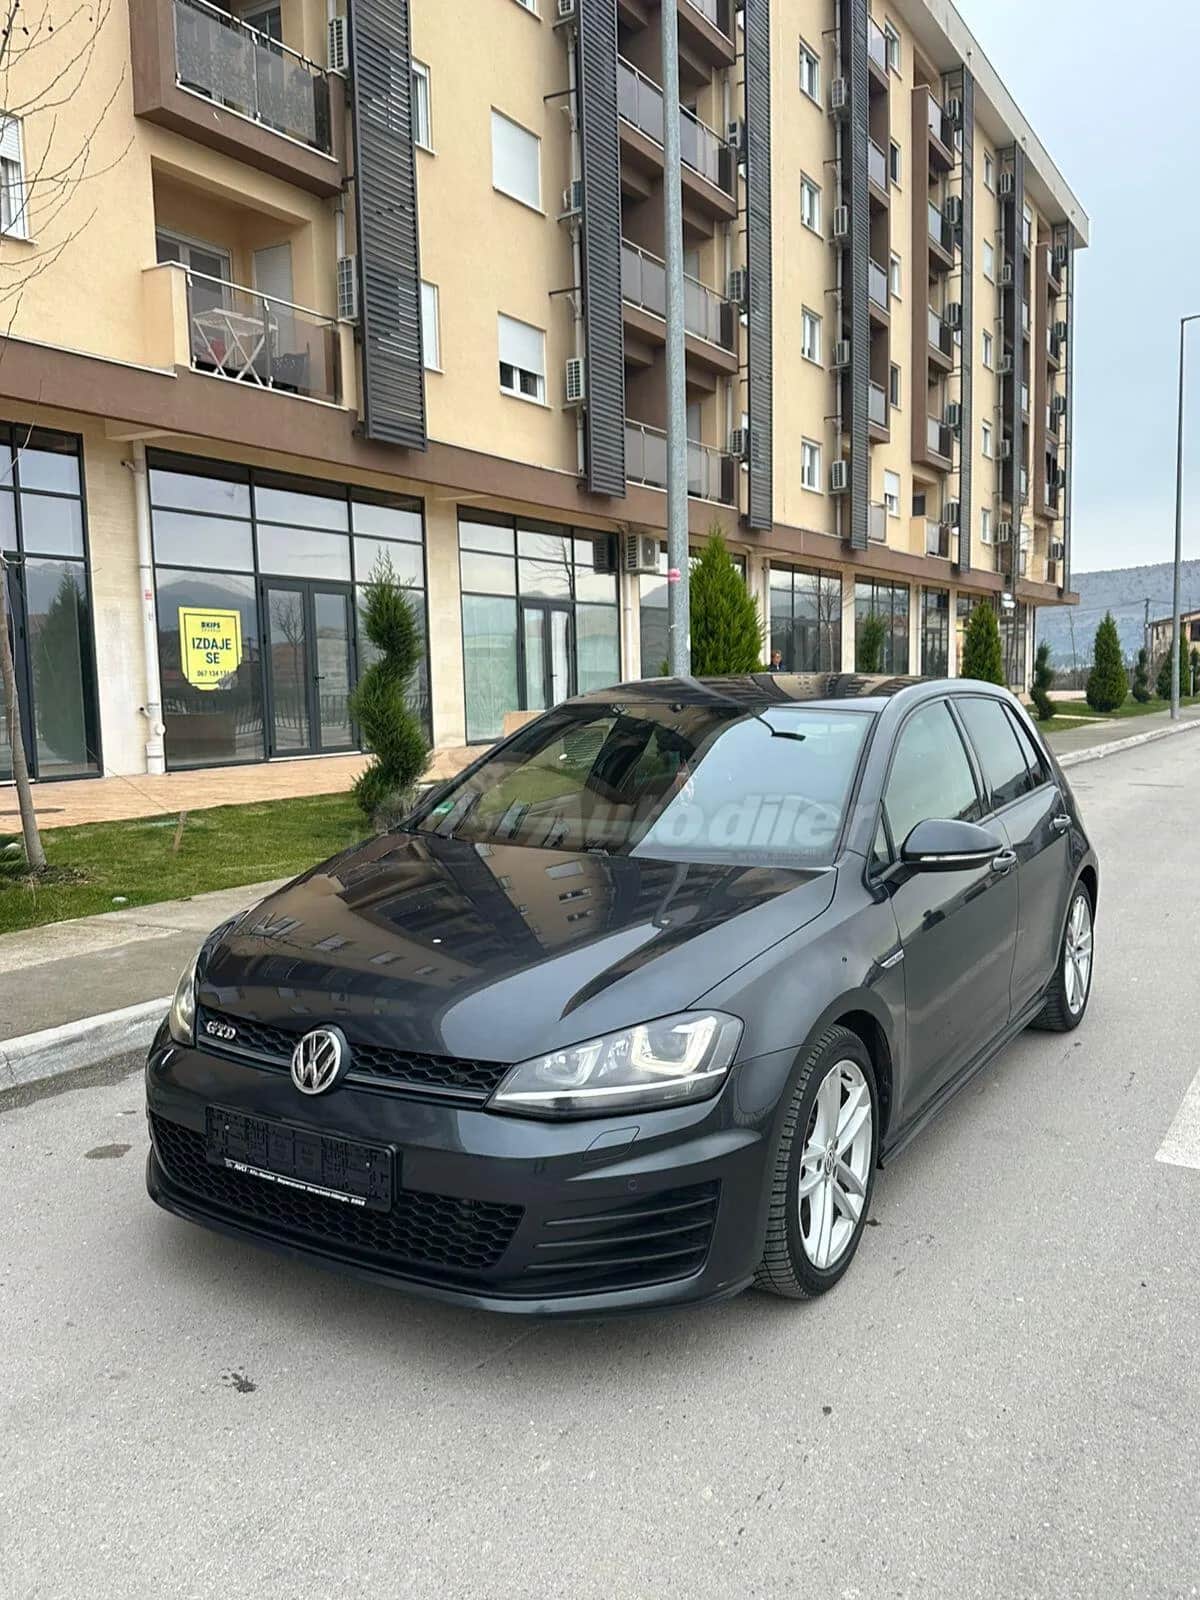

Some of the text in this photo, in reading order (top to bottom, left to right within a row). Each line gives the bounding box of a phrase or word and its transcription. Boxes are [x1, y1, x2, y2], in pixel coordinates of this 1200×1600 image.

[192, 637, 231, 650] IZDAJE
[206, 652, 220, 664] SE
[206, 1020, 237, 1040] GTD
